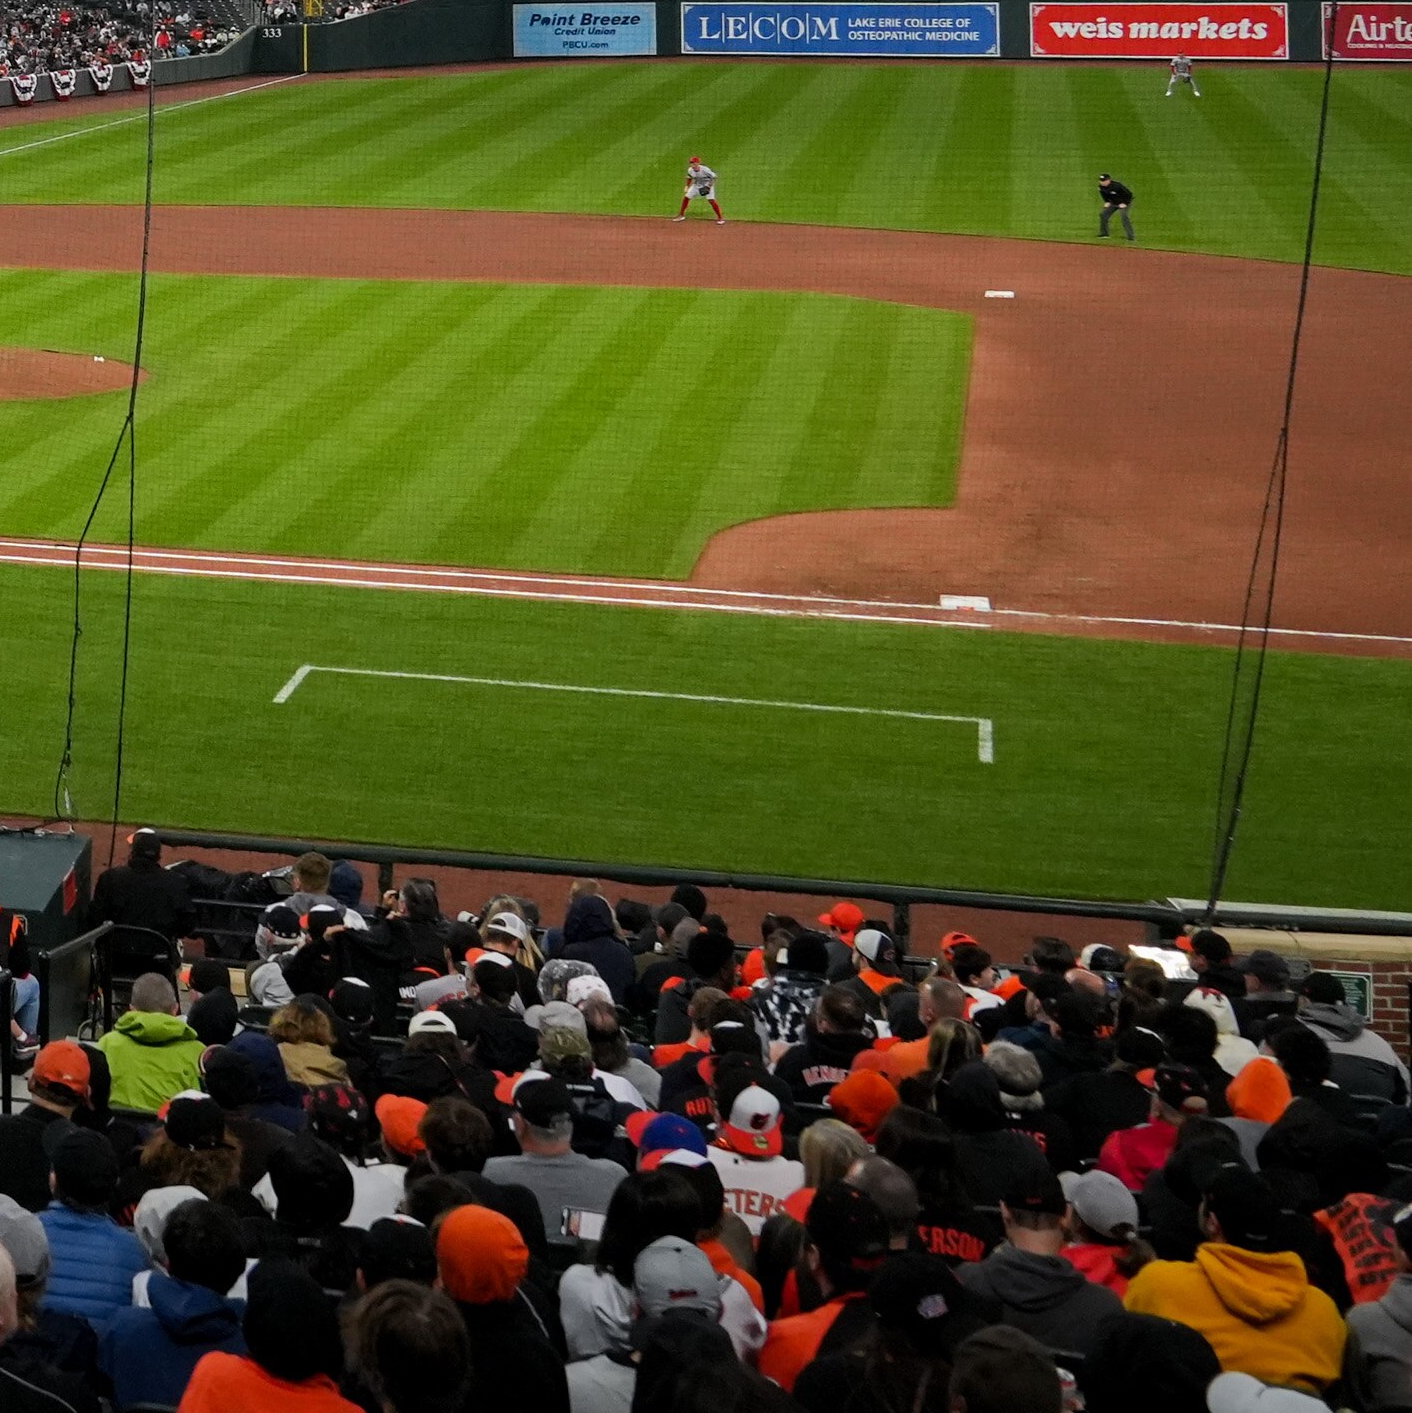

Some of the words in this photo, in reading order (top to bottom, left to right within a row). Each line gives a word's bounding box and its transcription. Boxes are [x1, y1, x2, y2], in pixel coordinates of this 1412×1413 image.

[529, 13, 578, 27] Point
[580, 13, 641, 26] Breeze
[848, 18, 875, 28] LAKE
[878, 18, 901, 28] ERIE
[904, 18, 953, 28] COLLEGE
[956, 18, 971, 28] OF
[262, 28, 281, 38] 333
[554, 28, 585, 36] Credit
[588, 28, 616, 36] Union
[1048, 17, 1124, 40] weis
[1128, 16, 1268, 40] markets
[848, 31, 923, 41] OSTEOPATHIC
[925, 31, 980, 41] MEDICINE
[562, 41, 609, 49] PBCU.com
